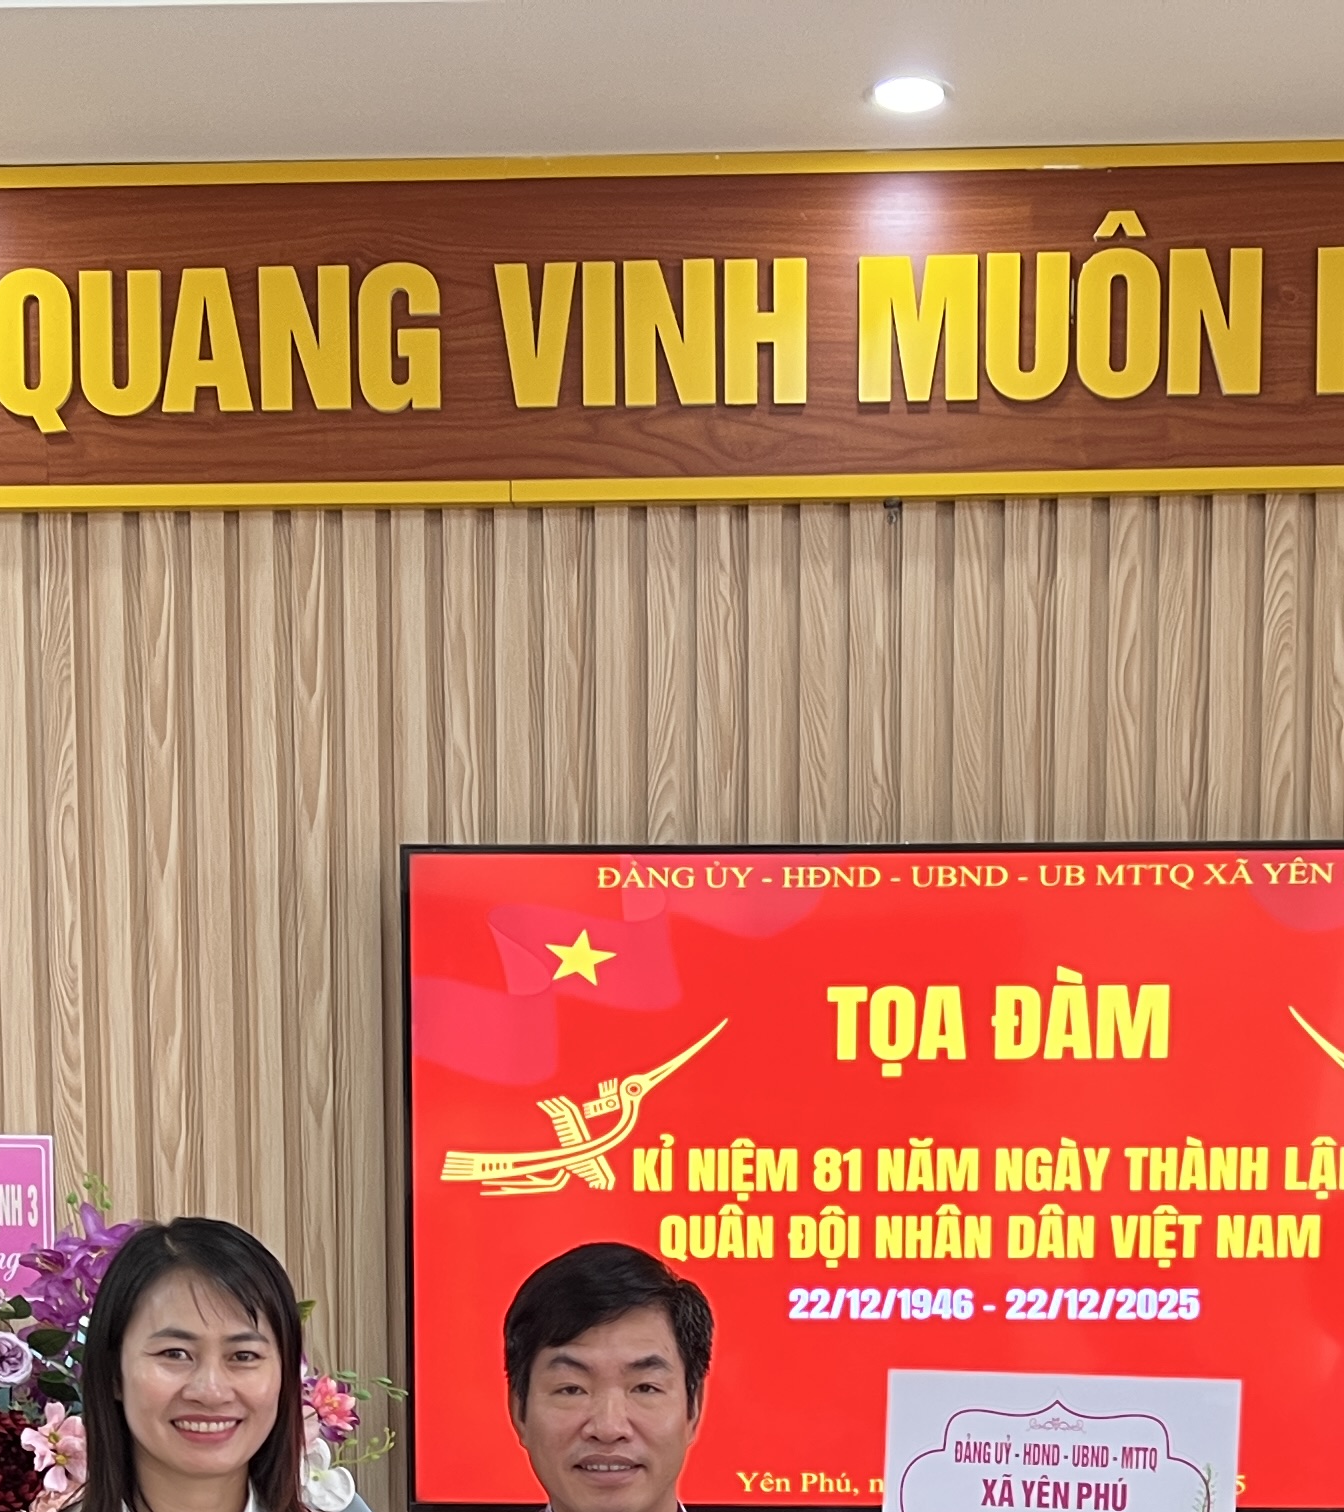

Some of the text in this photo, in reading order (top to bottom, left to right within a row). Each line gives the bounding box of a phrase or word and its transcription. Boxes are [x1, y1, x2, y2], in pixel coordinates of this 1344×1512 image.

[493, 257, 808, 408] VINH
[857, 210, 1263, 403] MUÔN
[597, 860, 695, 889] ĐẢNG
[706, 860, 754, 888] ỦY
[782, 865, 882, 889] HĐND
[911, 865, 1009, 888] UBND
[1039, 863, 1086, 887] UB
[1095, 863, 1195, 890] MTTQ
[1203, 859, 1254, 886] XÃ
[1263, 856, 1334, 885] YÊN
[826, 965, 1170, 1078] TỌA ĐÀM
[632, 1133, 675, 1192] KỈ
[688, 1137, 798, 1202] NIỆM
[813, 1148, 862, 1192] 81
[877, 1137, 979, 1192] NĂM
[995, 1136, 1111, 1192] NGÀY
[1123, 1135, 1269, 1191] THÀNH
[27, 1184, 39, 1228] 3
[659, 1203, 1321, 1269] QUÂN ĐỘI NHÂN DÂN VIỆT NAM
[788, 1288, 974, 1320] 22/12/1946
[1005, 1288, 1201, 1320] 22/12/2025
[954, 1433, 991, 1464] ĐẢNG
[1071, 1445, 1109, 1468] UBND
[1121, 1446, 1158, 1473] MTTQ
[736, 1471, 791, 1493] Yên
[800, 1471, 859, 1496] Phú,
[981, 1474, 1128, 1512] XÃ YÊN PHÚ
